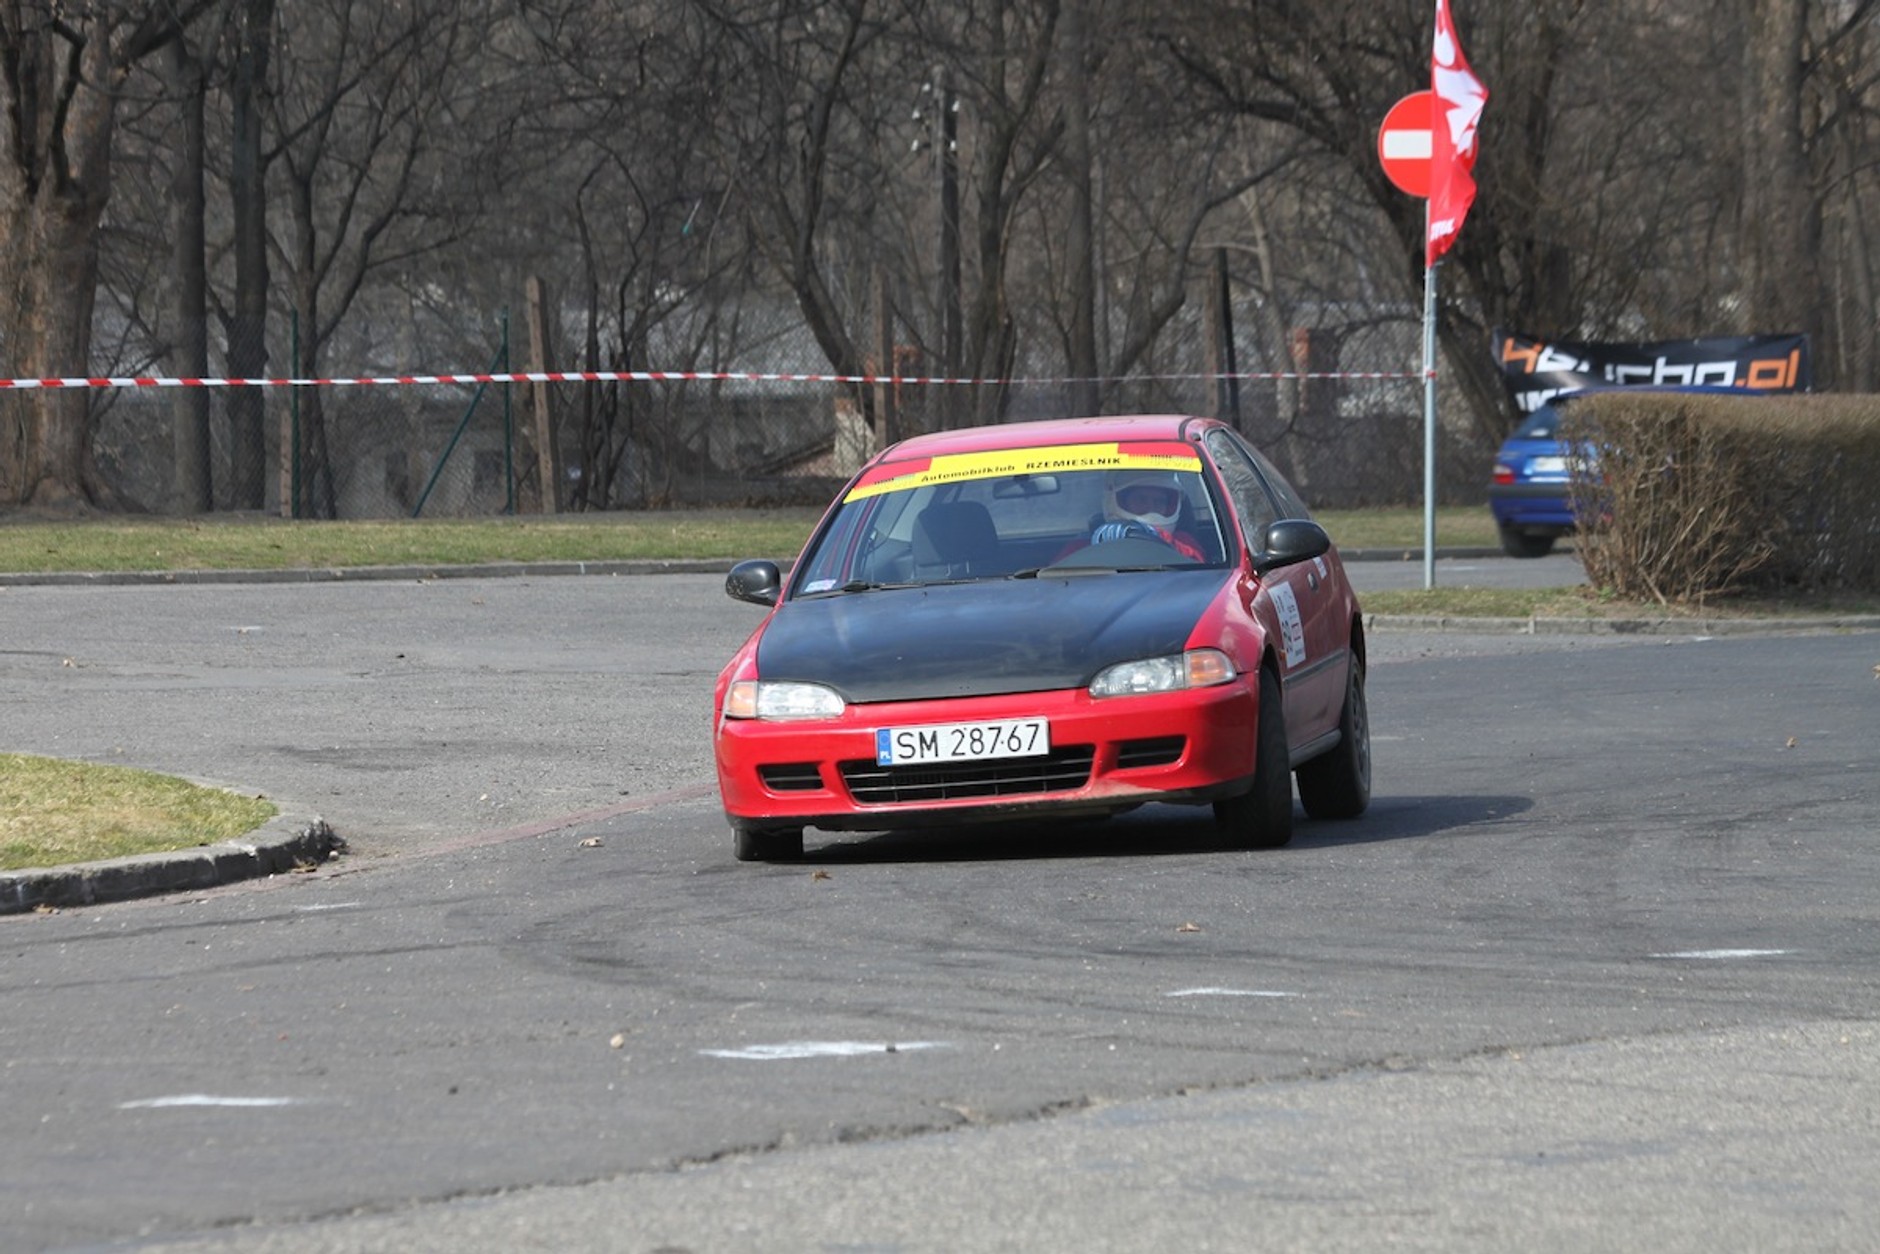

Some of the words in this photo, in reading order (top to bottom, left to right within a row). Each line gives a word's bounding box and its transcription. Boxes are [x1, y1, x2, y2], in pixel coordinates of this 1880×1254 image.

[922, 465, 1015, 482] Automobilklub
[897, 731, 939, 759] SM
[951, 724, 1040, 757] 28767
[880, 751, 890, 760] PL
